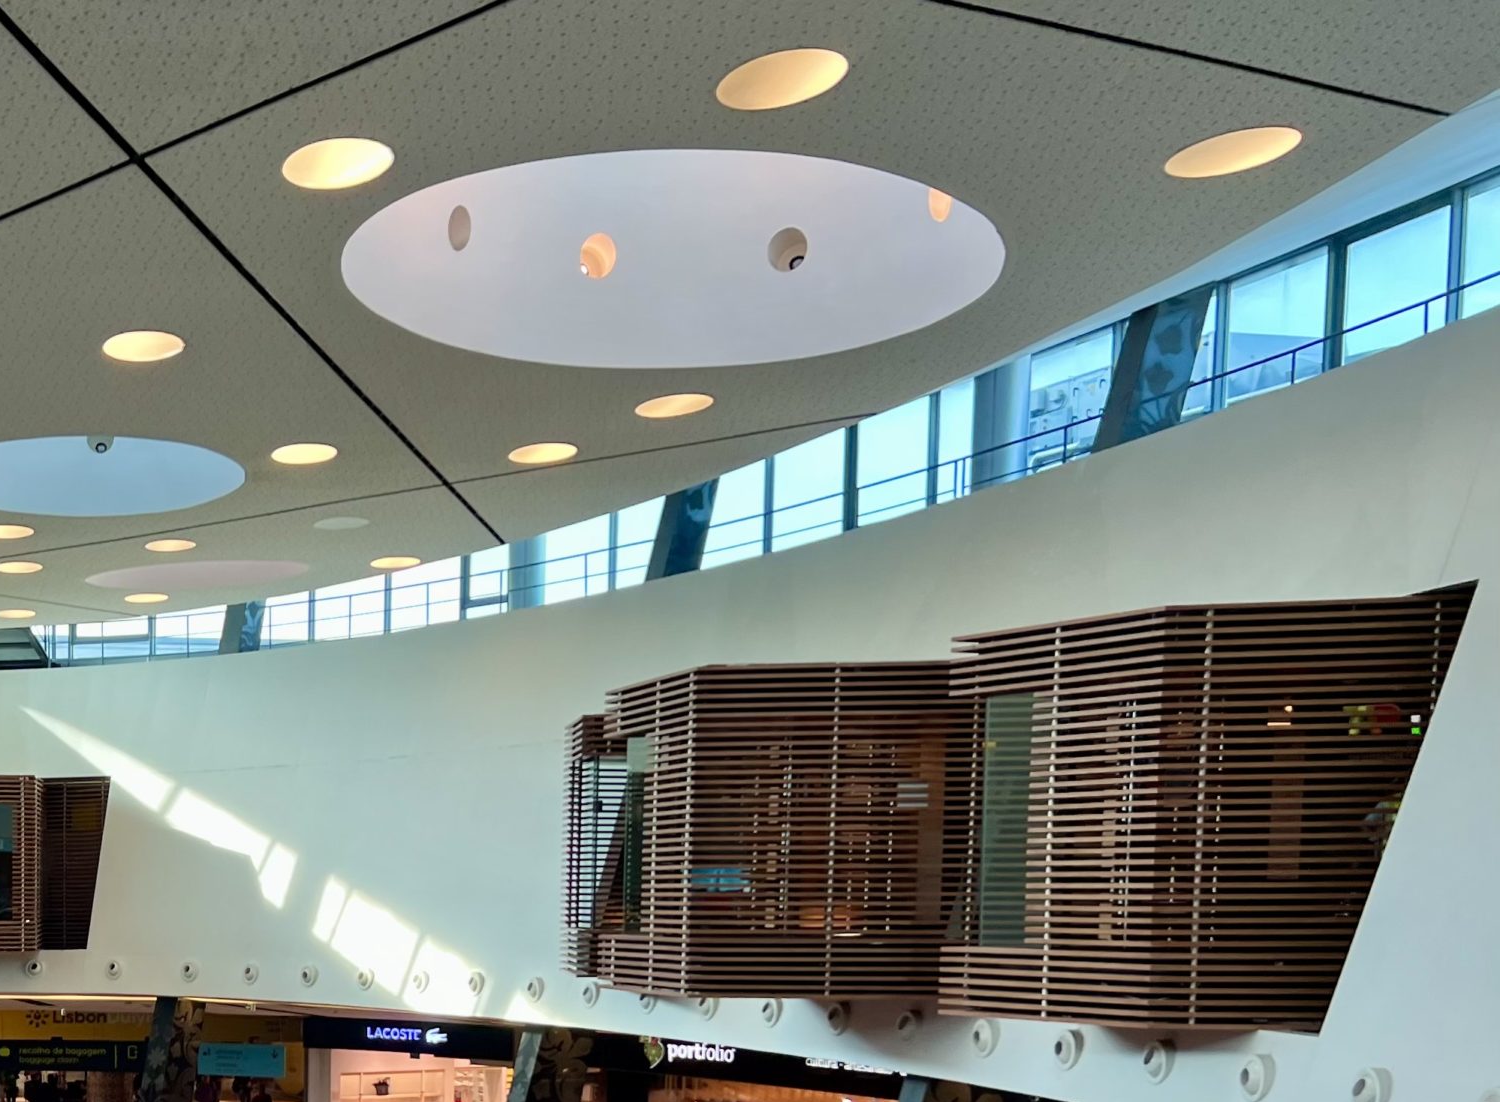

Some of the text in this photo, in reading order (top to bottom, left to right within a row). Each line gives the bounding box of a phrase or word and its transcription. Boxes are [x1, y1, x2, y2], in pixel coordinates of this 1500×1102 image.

[52, 1010, 107, 1024] Lisbon
[366, 1026, 422, 1041] LACOSTE
[667, 1043, 735, 1063] portfolio
